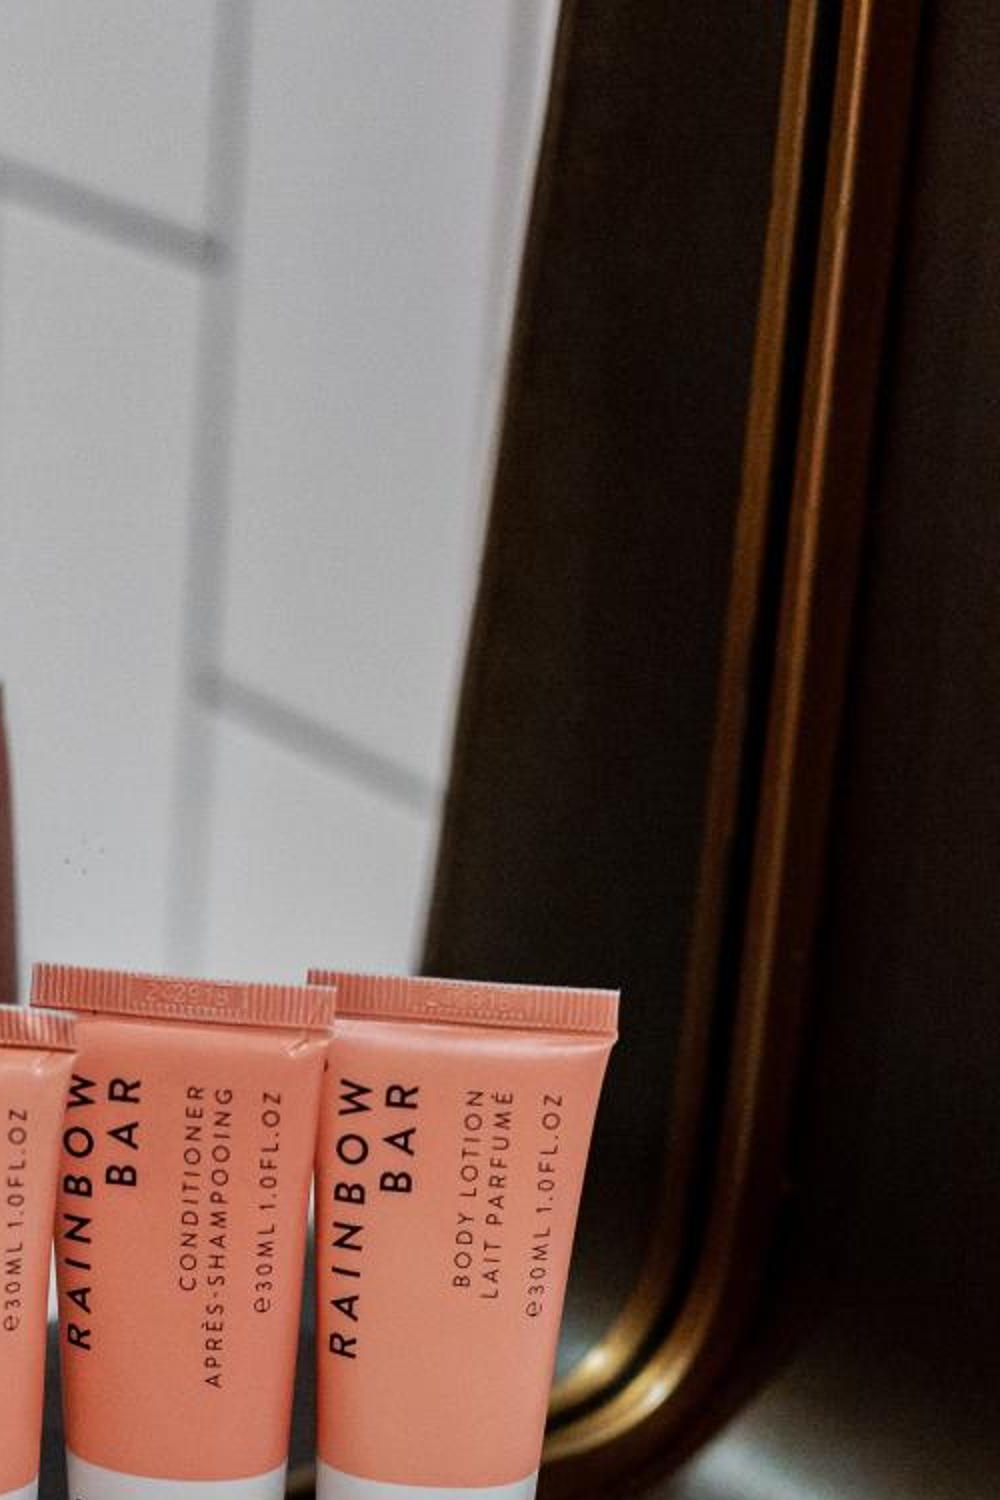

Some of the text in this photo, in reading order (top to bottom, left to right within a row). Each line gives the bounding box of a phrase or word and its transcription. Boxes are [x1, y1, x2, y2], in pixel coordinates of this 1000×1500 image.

[62, 1073, 97, 1351] RAINBOW
[105, 1076, 142, 1188] BAR
[178, 1085, 206, 1292] CONDITIONER
[329, 1078, 373, 1360] RAINBOW
[380, 1083, 420, 1194] BAR
[452, 1090, 485, 1288] BODY LOTION
[204, 1088, 233, 1389] APRÈS-SHAMPOOING
[481, 1230, 505, 1300] LAIT
